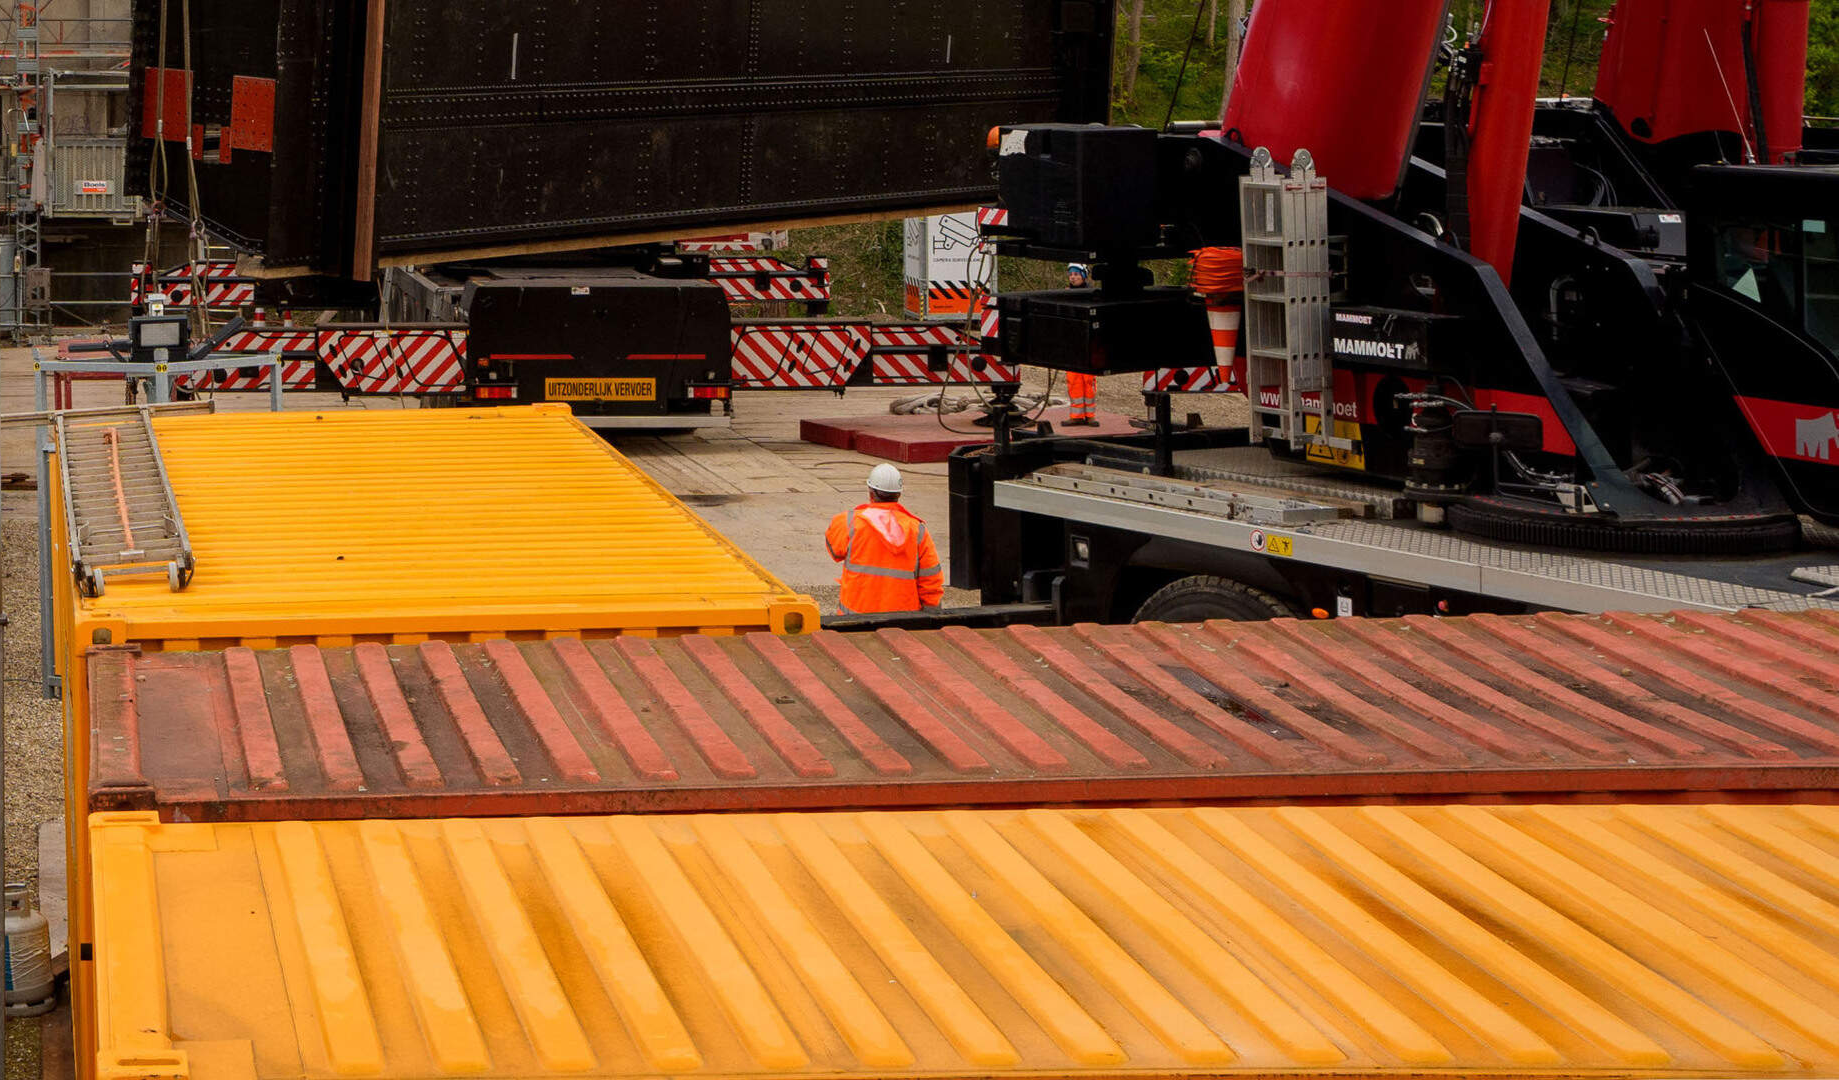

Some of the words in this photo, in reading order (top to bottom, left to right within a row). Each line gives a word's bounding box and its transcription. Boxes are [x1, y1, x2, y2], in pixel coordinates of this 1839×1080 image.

[1335, 313, 1373, 324] MAMMOET
[1333, 338, 1404, 360] MAMMOET
[548, 382, 613, 396] UITZONDERLIJK
[614, 382, 652, 396] VERVOER
